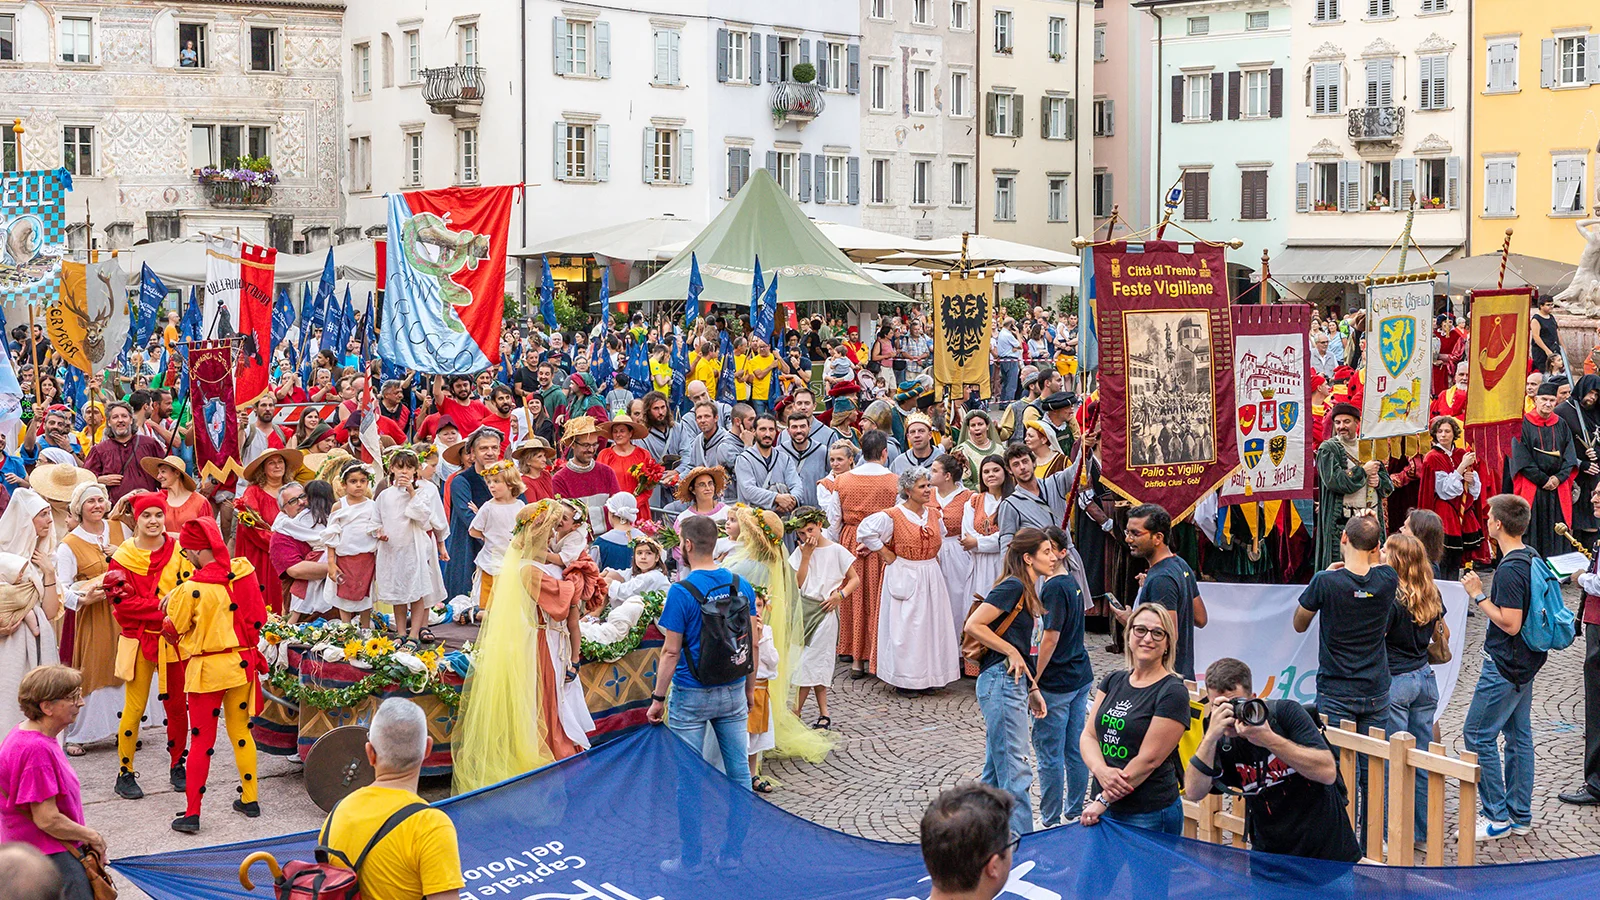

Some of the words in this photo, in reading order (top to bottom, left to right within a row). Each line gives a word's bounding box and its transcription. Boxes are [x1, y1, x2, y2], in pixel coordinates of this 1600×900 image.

[0, 176, 55, 207] ELL
[1127, 265, 1152, 277] Città
[1153, 264, 1163, 276] di
[1164, 264, 1197, 277] Trento
[1111, 281, 1152, 297] Feste
[1153, 280, 1214, 298] Vigiliane
[1140, 467, 1165, 477] Palio
[1166, 466, 1176, 476] S.
[1177, 463, 1205, 477] Vigilio
[1255, 470, 1267, 488] di
[1106, 707, 1128, 718] KEEP
[1101, 713, 1126, 731] PRO
[1103, 733, 1121, 745] STAY
[1106, 728, 1118, 736] AND
[521, 840, 565, 863] del
[461, 856, 529, 883] Volo
[477, 855, 587, 896] Capitale
